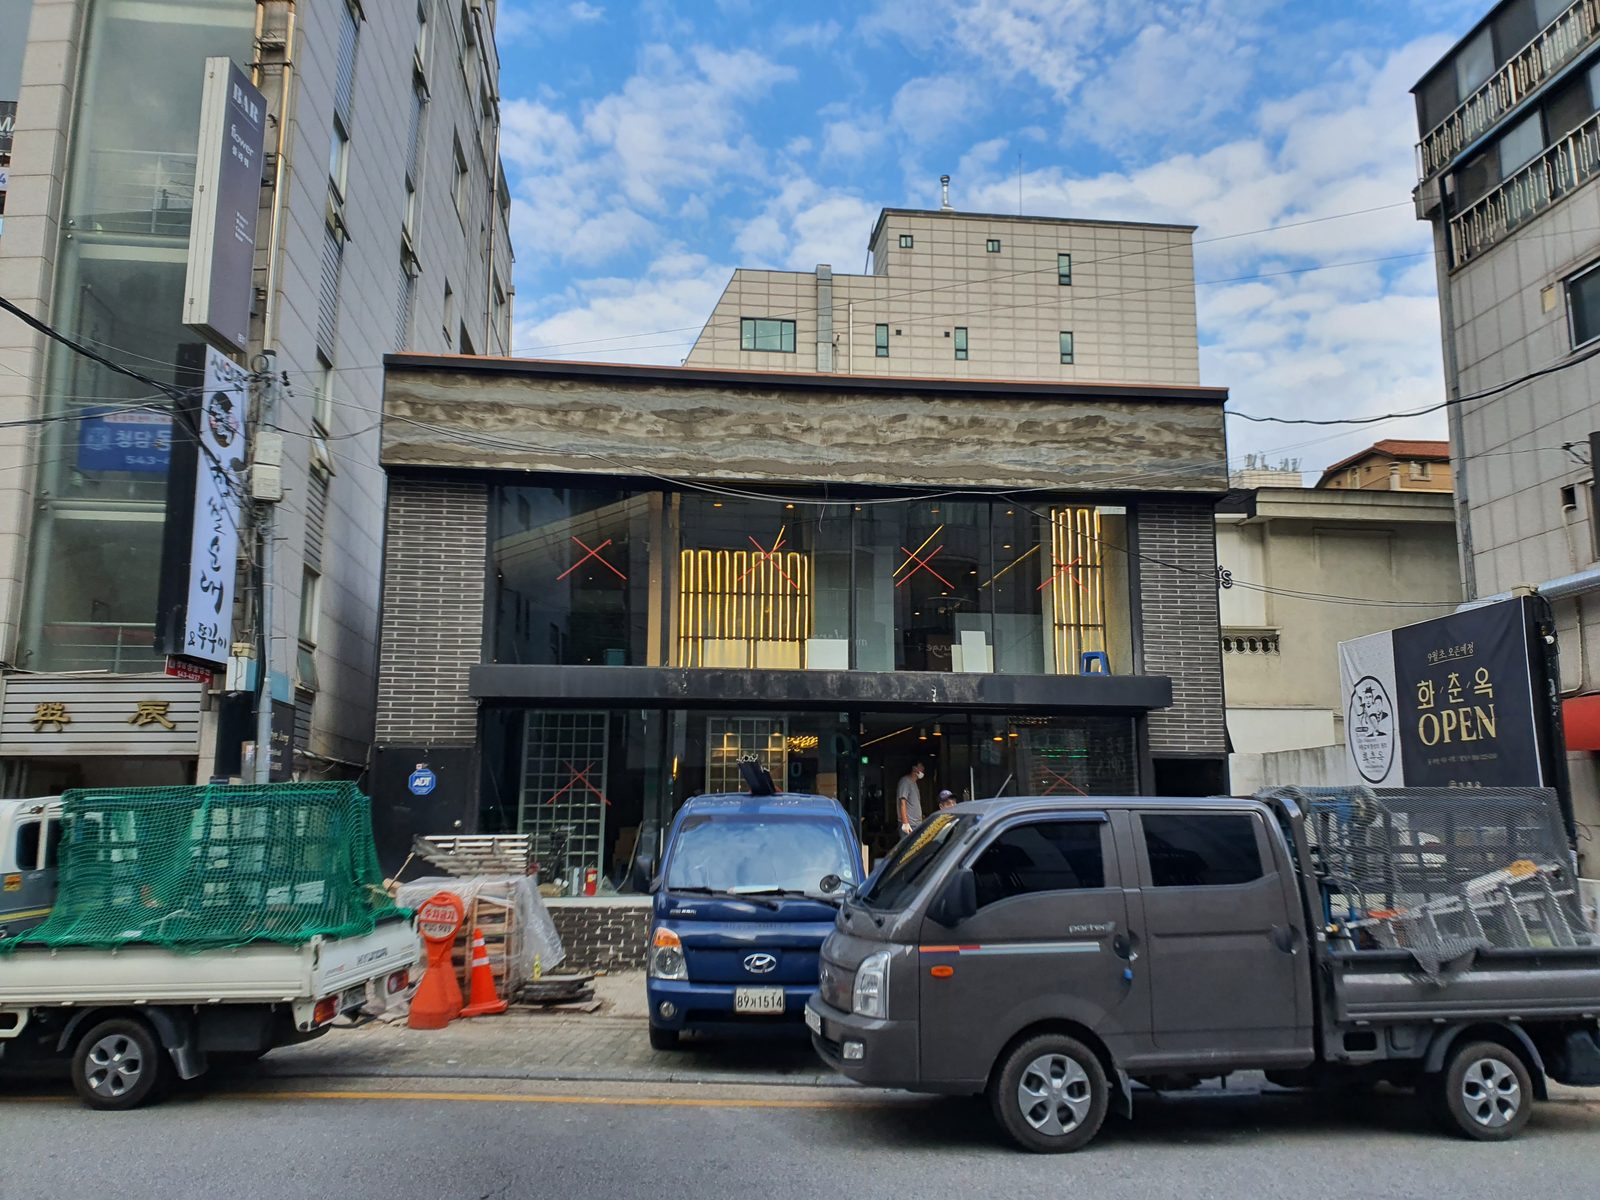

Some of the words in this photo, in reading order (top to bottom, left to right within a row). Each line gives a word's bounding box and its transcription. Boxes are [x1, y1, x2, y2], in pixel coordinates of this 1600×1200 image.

[232, 82, 259, 124] BAR
[1418, 703, 1497, 746] OPEN
[413, 777, 432, 787] ADT
